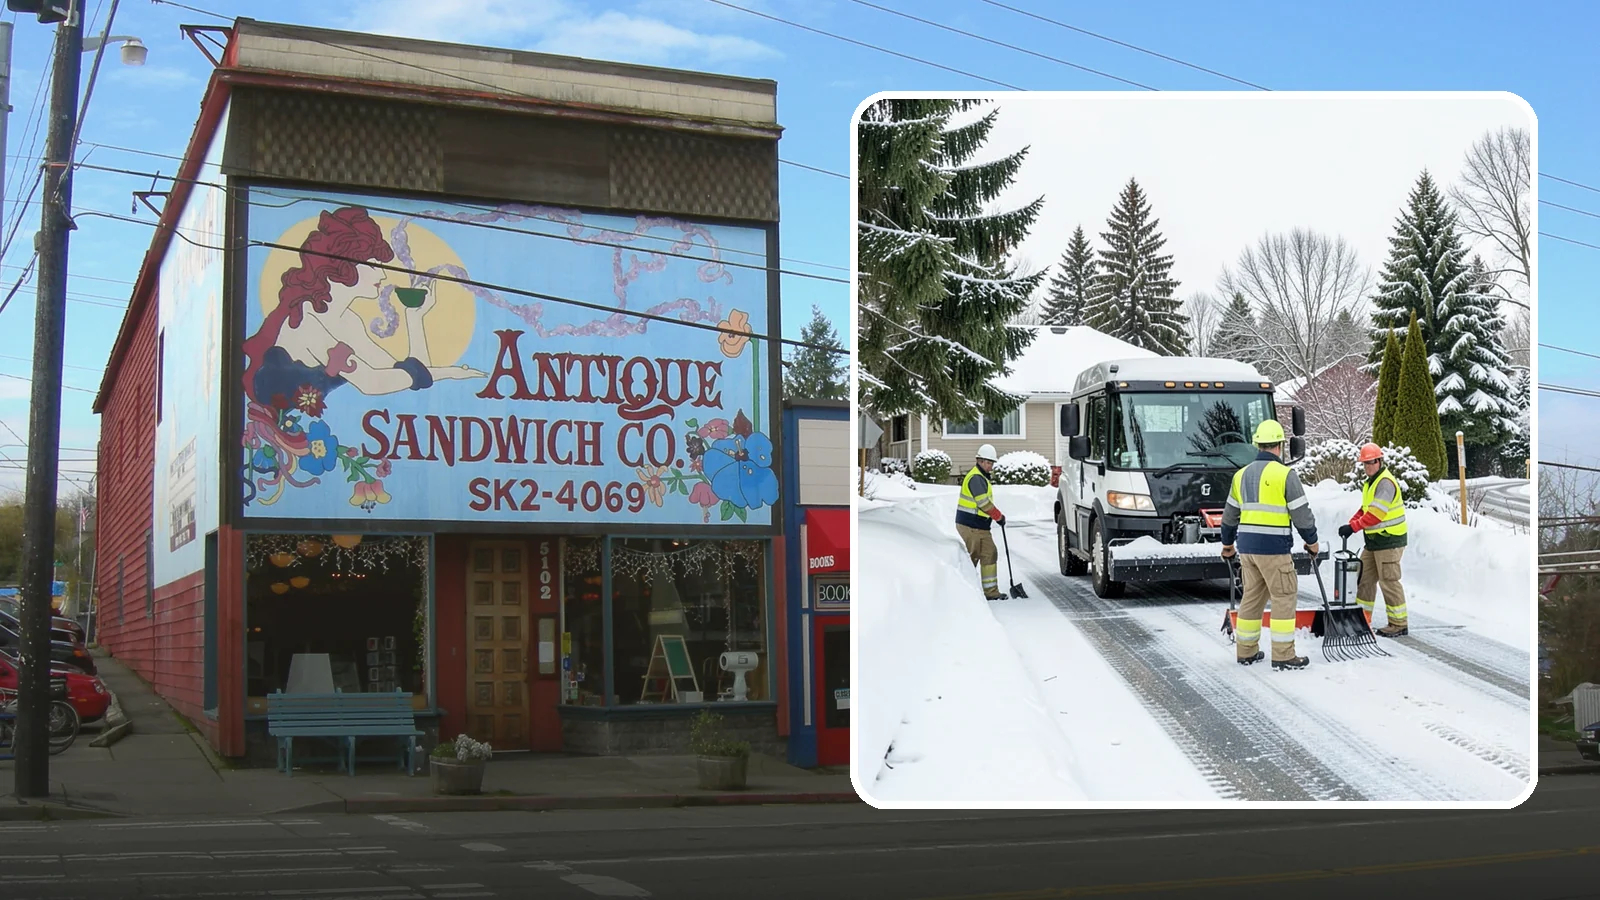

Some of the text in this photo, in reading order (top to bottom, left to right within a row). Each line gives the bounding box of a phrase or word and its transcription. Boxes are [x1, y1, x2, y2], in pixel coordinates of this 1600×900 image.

[476, 329, 723, 420] ANTIQUE
[361, 409, 685, 469] SANDWICH CO.
[468, 478, 646, 513] SK2-4069
[540, 542, 551, 599] 5102
[809, 556, 834, 568] BOOKS
